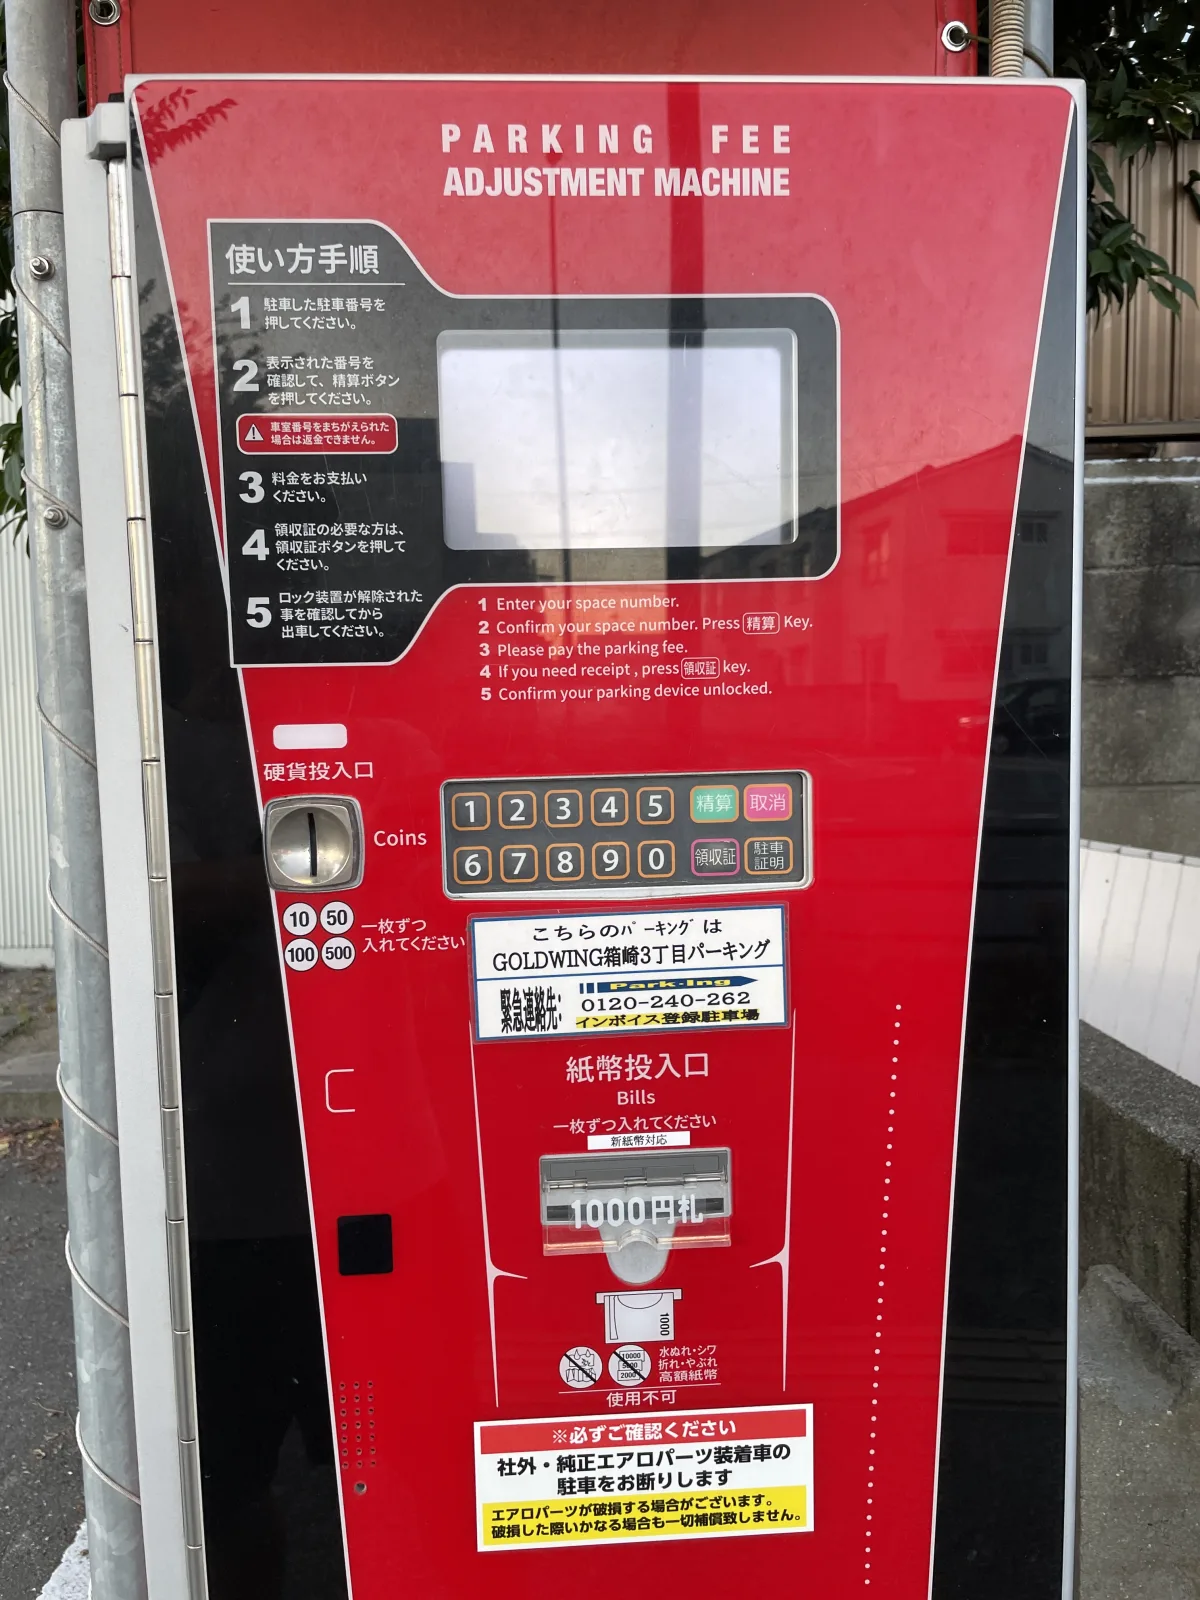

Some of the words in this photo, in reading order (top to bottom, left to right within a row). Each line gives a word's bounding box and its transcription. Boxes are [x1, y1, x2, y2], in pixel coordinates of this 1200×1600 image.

[441, 124, 653, 154] PARKING
[712, 125, 791, 154] FEE
[443, 168, 644, 197] ADJUSTMENT
[655, 168, 790, 197] MACHINE
[225, 243, 379, 275] 使い方手順
[231, 296, 251, 329] 1
[264, 298, 386, 312] 駐車した駐車番号を
[265, 316, 356, 330] 押してください。
[267, 356, 374, 370] 表示された番号を
[233, 360, 260, 392] 2
[268, 392, 373, 406] を押してください。
[270, 422, 390, 433] 車室番号をまちがえられた
[271, 434, 375, 445] 場合は返金できません。
[239, 471, 265, 504] 3
[272, 471, 367, 486] 料金をお支払い
[273, 490, 326, 503] ください。
[275, 523, 404, 537] 領収証の必要な方は、
[242, 529, 270, 561] 4
[275, 540, 406, 554] 領収証ボタンを押して
[276, 559, 329, 571] ください。
[279, 590, 423, 604] ロック装置が解除された
[478, 598, 488, 611] 1
[497, 598, 535, 611] Enter
[538, 599, 573, 614] your
[575, 598, 616, 613] space
[620, 595, 679, 609] number.
[246, 597, 272, 628] 5
[280, 608, 383, 621] 事を確認してから
[282, 625, 384, 638] 出車してください。
[478, 621, 490, 635] 2
[496, 621, 555, 635] Confirm
[558, 622, 592, 636] your
[594, 621, 635, 636] space
[639, 618, 698, 632] number.
[702, 617, 741, 631] Press
[746, 616, 776, 631] 精算
[784, 616, 814, 630] Key.
[479, 644, 490, 657] 3
[498, 644, 544, 657] Please
[548, 645, 574, 659] pay
[577, 642, 600, 656] the
[604, 641, 659, 657] parking
[662, 641, 688, 655] fee.
[479, 665, 491, 679] 4
[498, 665, 509, 678] If
[511, 667, 538, 681] you
[541, 663, 577, 678] need
[642, 664, 679, 678] press
[683, 662, 717, 676] 領収証
[723, 660, 751, 675] key.
[481, 687, 491, 701] 5
[499, 686, 557, 701] Confirm
[560, 688, 593, 703] your
[597, 686, 651, 701] parking
[654, 684, 700, 698] device
[703, 682, 773, 696] unlocked.
[264, 761, 373, 781] 硬貨投入口
[464, 801, 476, 822] 1
[510, 799, 525, 822] 2
[556, 798, 571, 820] 3
[601, 796, 618, 818] 4
[648, 795, 663, 817] 5
[696, 793, 733, 812] 精算
[749, 793, 786, 812] 取消
[374, 830, 427, 847] Coins
[695, 848, 736, 867] 領収証
[754, 842, 783, 855] 駐車
[465, 854, 481, 877] 6
[512, 853, 526, 875] 7
[558, 851, 573, 873] 8
[603, 849, 619, 872] 9
[649, 848, 665, 870] 0
[754, 857, 784, 870] 証明
[290, 911, 309, 927] 10
[326, 909, 347, 925] 50
[361, 918, 426, 934] 一枚ずつ
[325, 946, 352, 960] 500
[362, 935, 465, 953] 入れてください
[288, 947, 314, 962] 100
[581, 992, 751, 1012] 0120-240-262
[576, 1009, 760, 1028] インボイス登録駐車場
[566, 1053, 709, 1083] 紙幣投入口
[617, 1090, 656, 1105] Bills
[553, 1115, 717, 1134] 一枚ずつ入れてください
[611, 1134, 667, 1147] 新紙幣対応
[571, 1194, 703, 1229] 1000円札
[660, 1313, 670, 1336] 1000
[659, 1345, 717, 1357] 水ぬれ・シワ
[658, 1358, 718, 1370] 折れ・やぶれ
[659, 1370, 718, 1382] 高額紙幣
[606, 1390, 677, 1407] 使用不可
[497, 1443, 791, 1476] 社外・純正エアロパーツ装着車の
[557, 1469, 733, 1496] 駐車をお断りします
[491, 1494, 773, 1522] エアロパーツが破損する場合がございます。
[492, 1510, 801, 1540] 破損した際いかなる場合も一切補償致しません。
